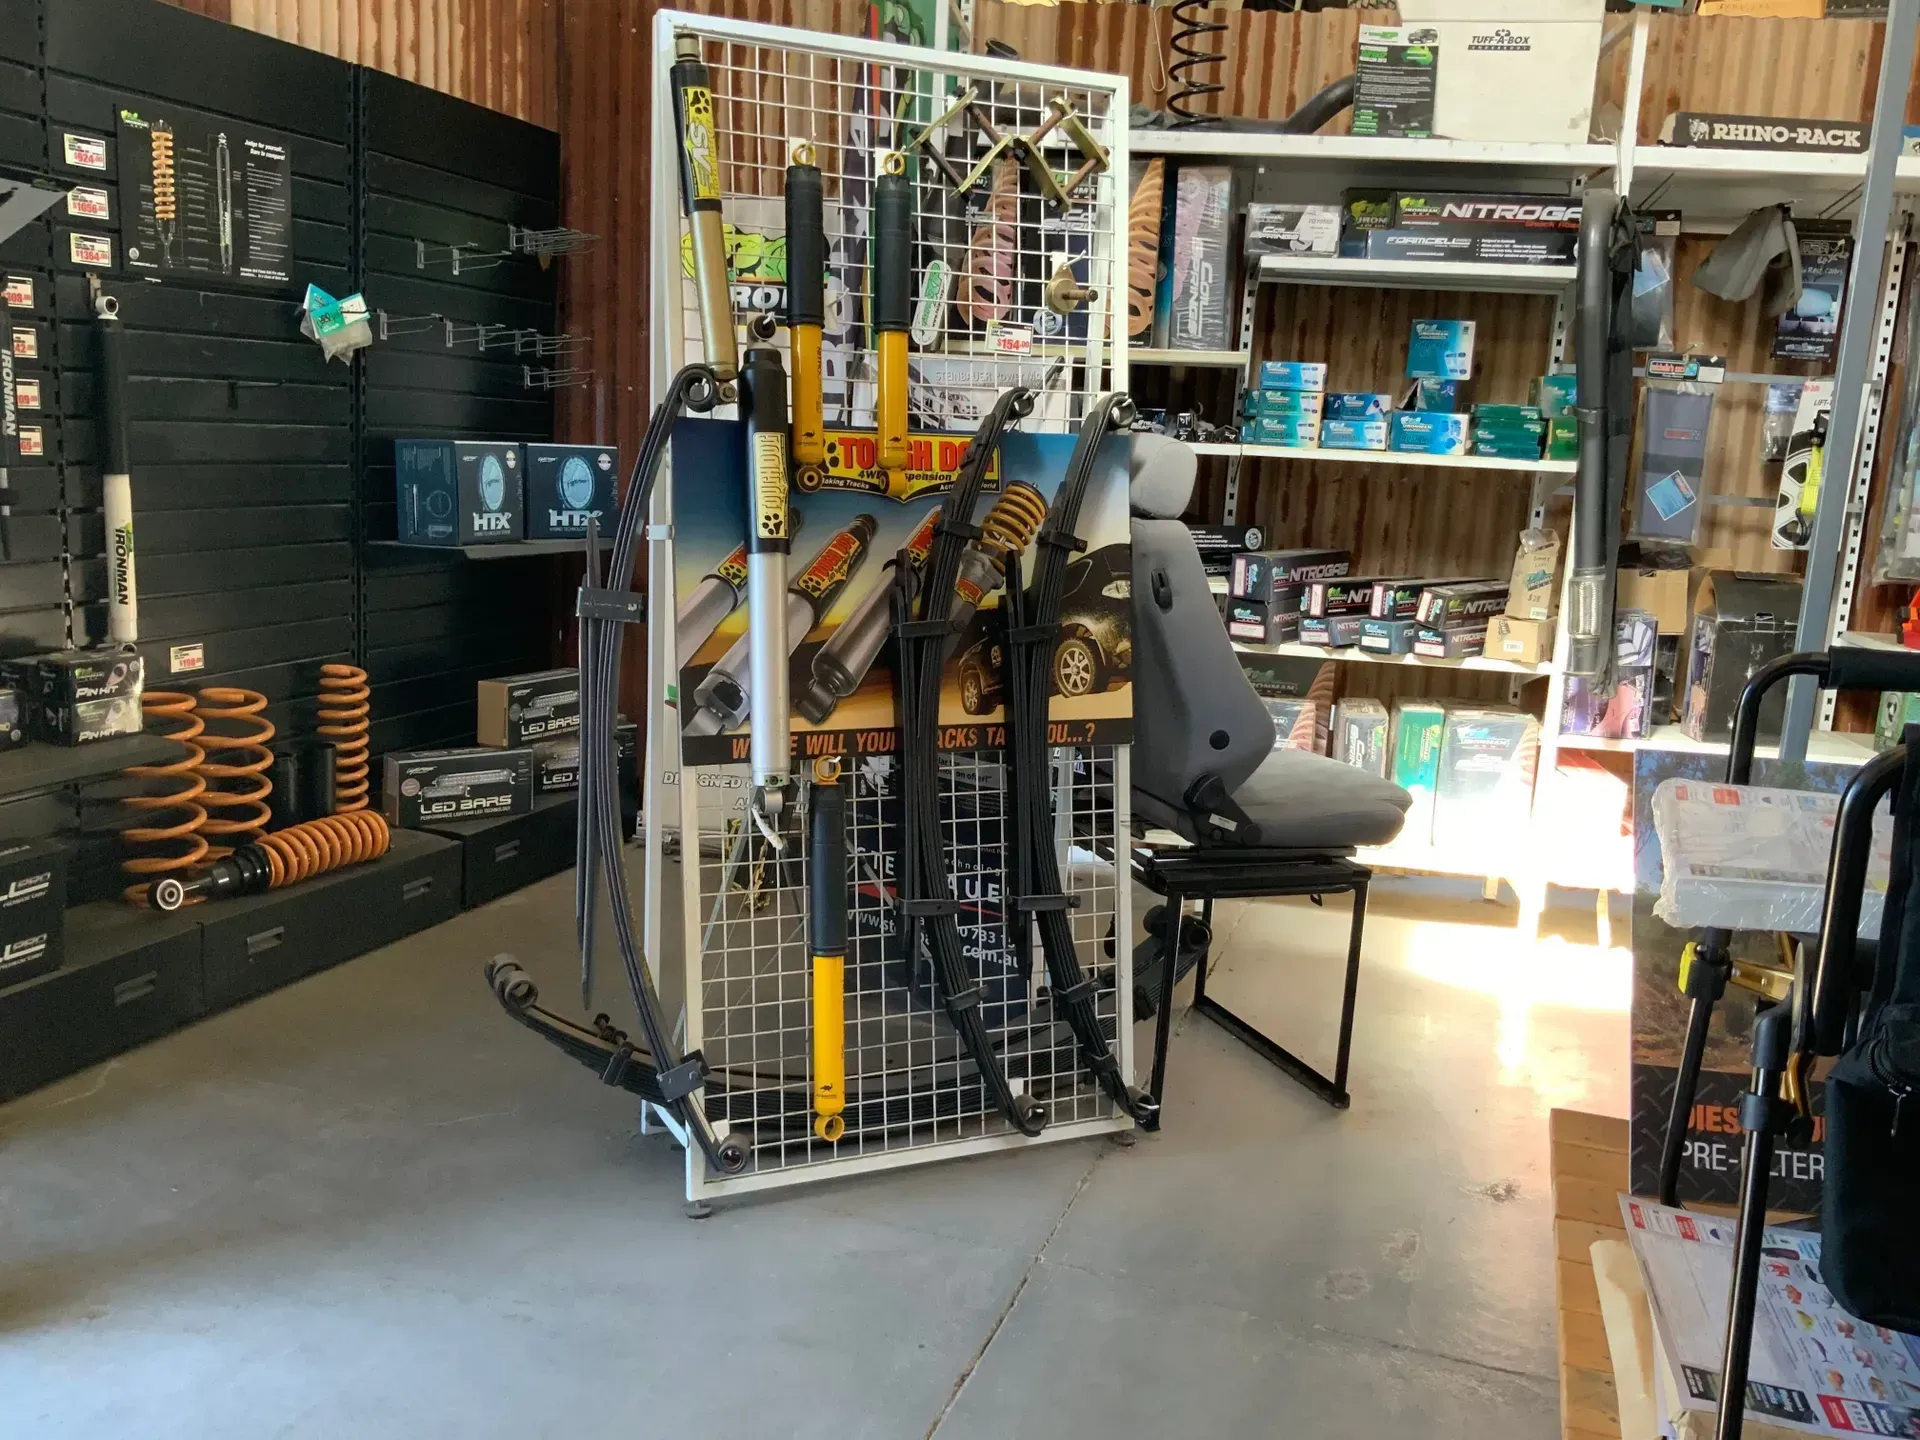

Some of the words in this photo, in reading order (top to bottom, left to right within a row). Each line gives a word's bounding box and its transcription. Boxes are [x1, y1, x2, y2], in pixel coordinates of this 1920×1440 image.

[1472, 36, 1530, 44] TUFF-A-BOX
[1713, 123, 1861, 147] RHINO-RACK
[1442, 203, 1583, 221] NITROGA
[1, 348, 17, 436] IRONMAN
[838, 438, 932, 471] TOH
[846, 480, 870, 489] Tracks
[981, 482, 997, 490] orld
[473, 512, 513, 531] HTX
[114, 528, 129, 605] IRONMAN
[1290, 562, 1348, 582] NITROGAS
[1337, 621, 1359, 630] NITRO
[1251, 683, 1296, 691] RONMAN
[521, 719, 545, 735] LED
[547, 714, 580, 731] BARS
[806, 734, 847, 755] WILL
[542, 772, 573, 785] LED
[420, 800, 457, 815] LED
[460, 794, 512, 810] BARS
